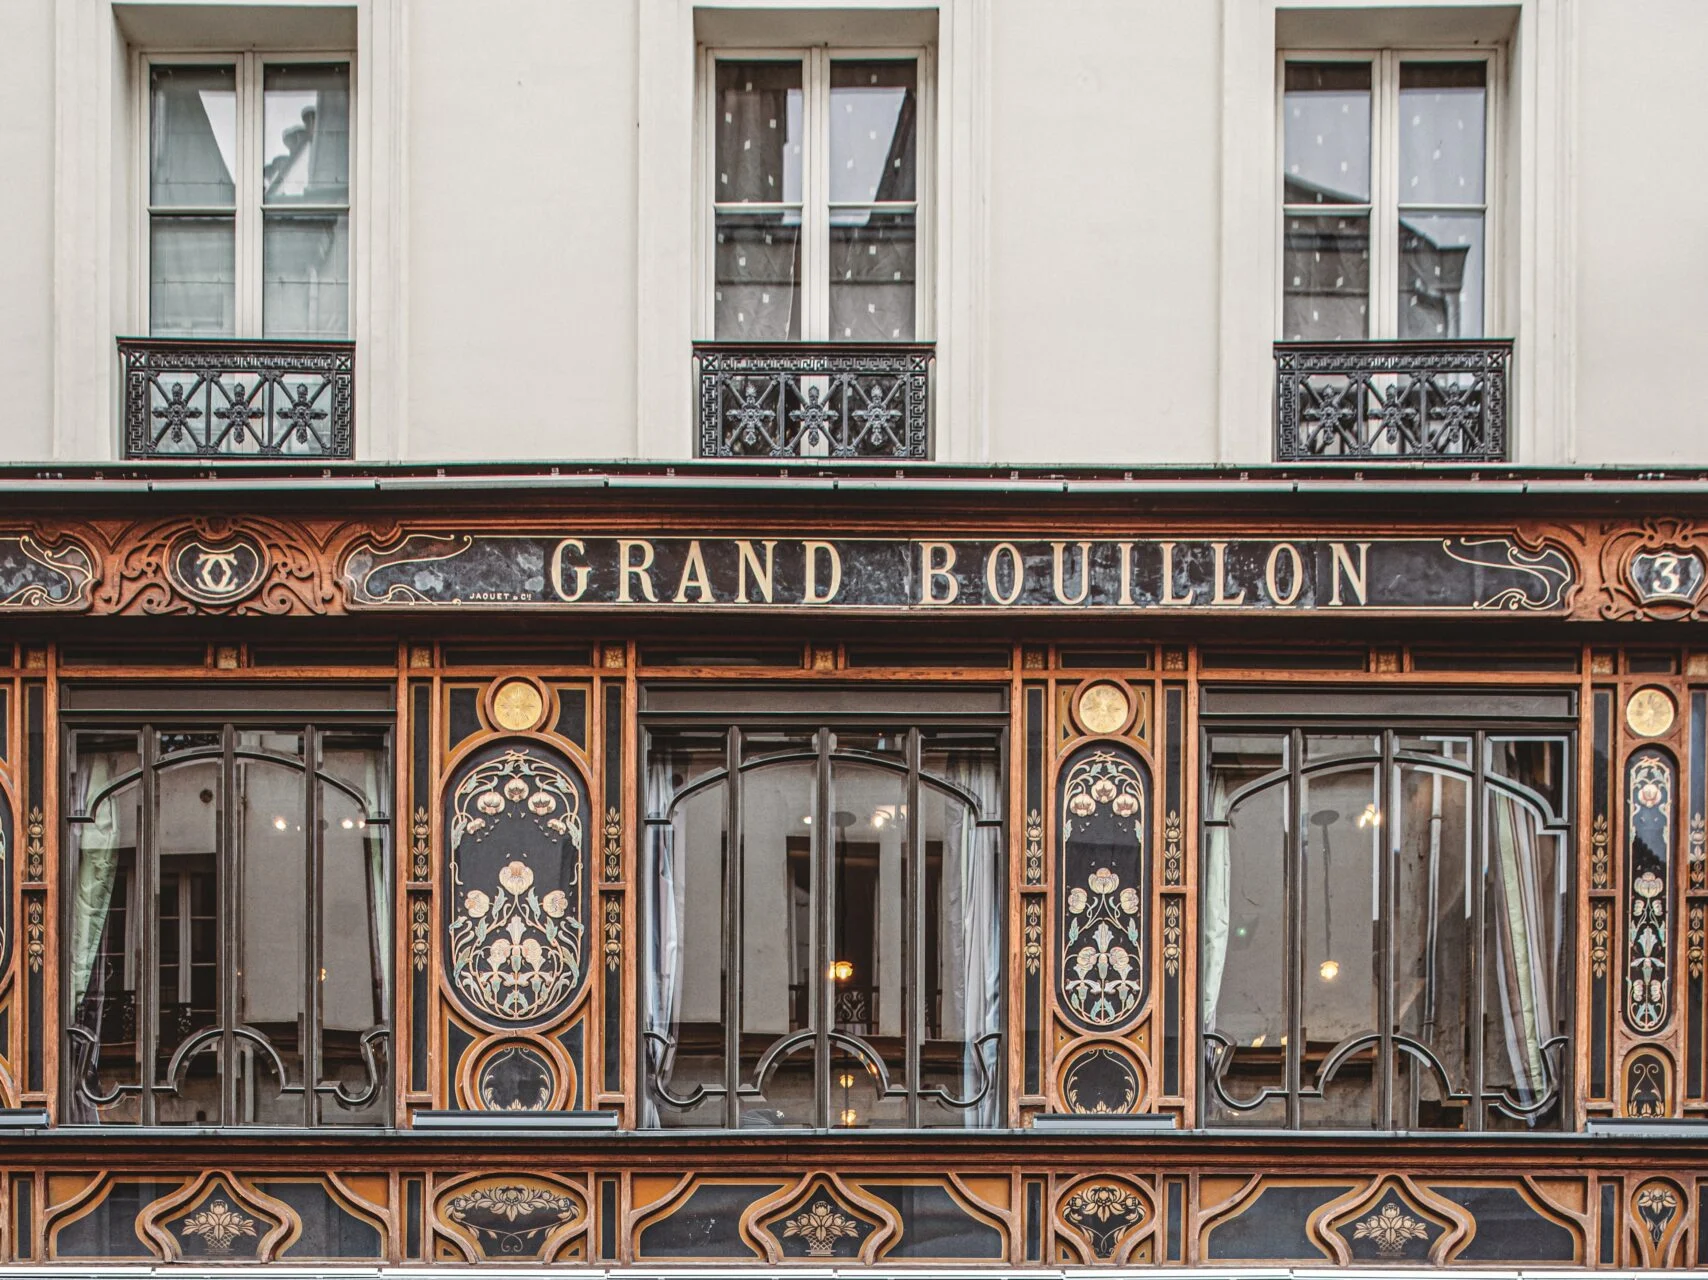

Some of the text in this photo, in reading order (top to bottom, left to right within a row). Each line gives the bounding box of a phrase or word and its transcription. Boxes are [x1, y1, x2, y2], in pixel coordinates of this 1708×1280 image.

[550, 538, 1371, 607] GRAND BOUILLON
[1652, 555, 1682, 595] 3
